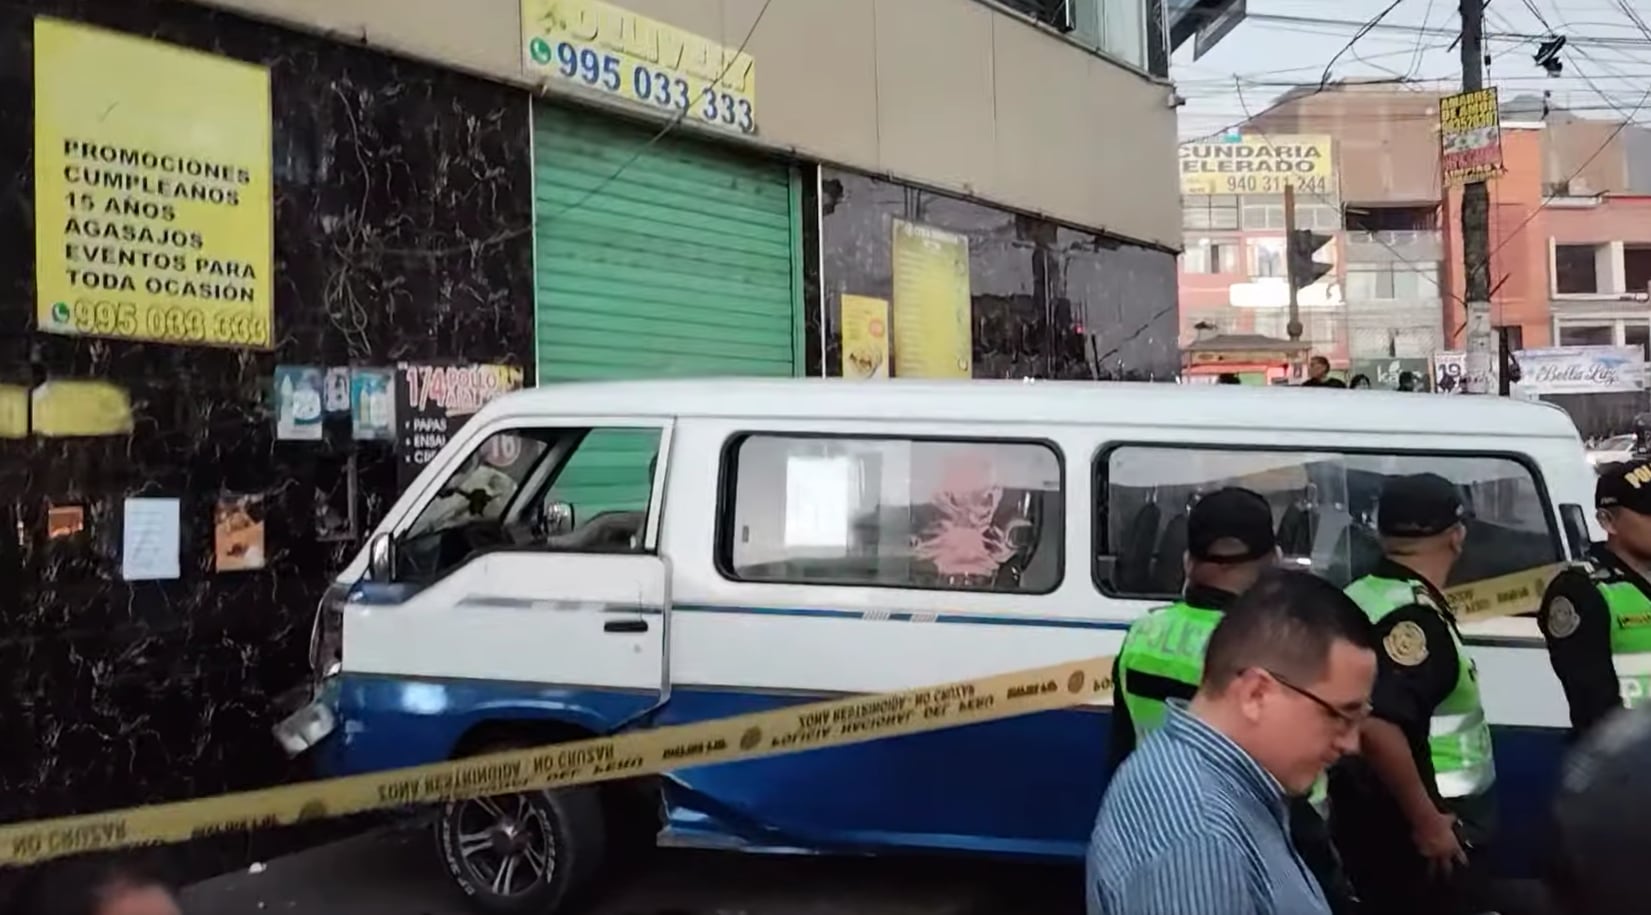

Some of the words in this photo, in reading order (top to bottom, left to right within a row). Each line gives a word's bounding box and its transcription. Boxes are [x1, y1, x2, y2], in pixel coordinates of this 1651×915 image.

[557, 42, 622, 92] 995
[633, 66, 691, 116] 033
[701, 86, 754, 134] 333
[63, 138, 250, 185] PROMOCIONES
[1182, 160, 1316, 173] ELERADO
[1227, 175, 1257, 191] 940
[1297, 175, 1326, 192] 244
[65, 192, 95, 211] 15
[104, 196, 176, 222] AÑOS
[64, 218, 204, 249] AGASAJOS
[64, 244, 187, 272] EVENTOS
[195, 257, 256, 280] PARA
[65, 269, 135, 292] TODA
[145, 278, 255, 303] OCASIÓN
[74, 299, 139, 336] 995
[413, 419, 447, 433] PAPAS
